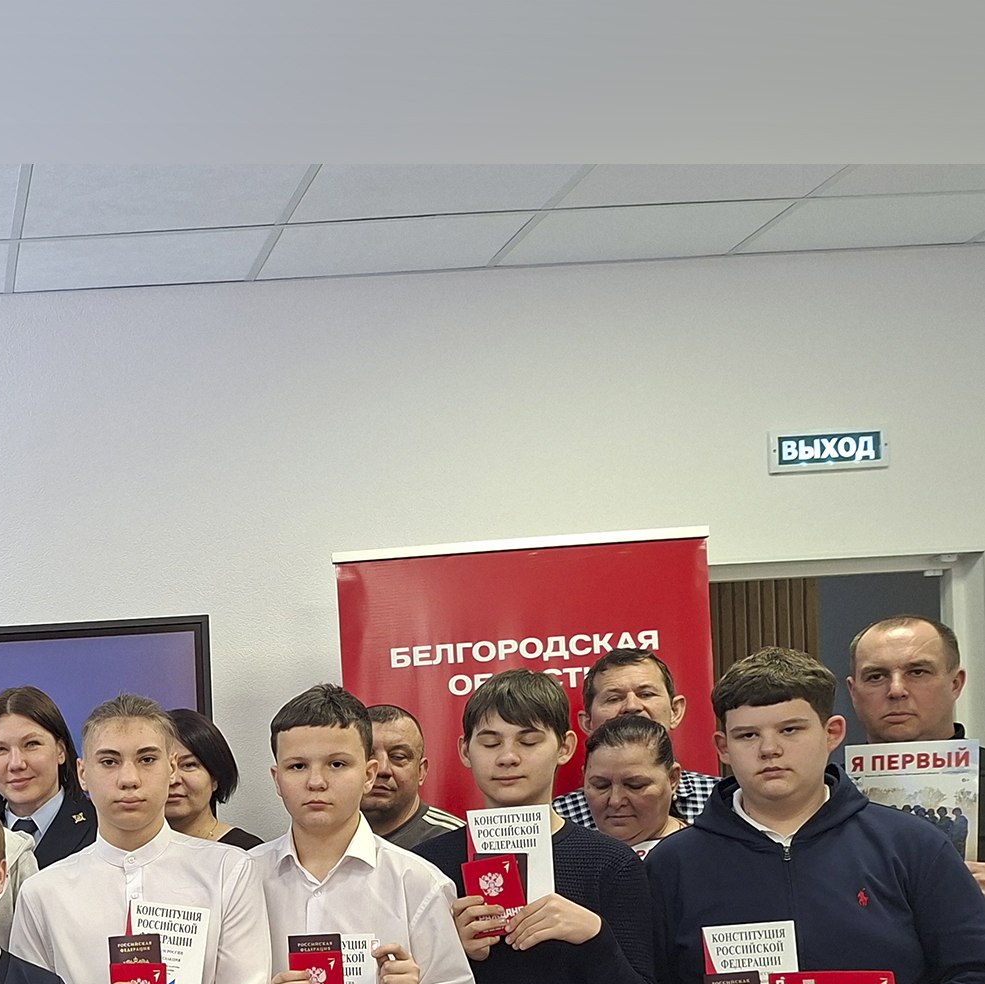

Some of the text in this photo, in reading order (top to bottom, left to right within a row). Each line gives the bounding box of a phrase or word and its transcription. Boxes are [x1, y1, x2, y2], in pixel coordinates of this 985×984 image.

[782, 436, 876, 461] ВЫХОД
[390, 630, 659, 668] БЕЛГОРОДСКАЯ
[851, 747, 970, 772] Я ПЕРВЫЙ
[474, 812, 541, 826] КОНСТИТУЦИЯ
[477, 823, 539, 838] РОССИЙСКОЙ
[481, 838, 536, 850] ФЕДЕРАЦИИ
[136, 905, 202, 922] КОНСТИТУЦИЯ
[137, 918, 197, 934] РОССИЙСКОЙ
[161, 934, 192, 947] РАЦИИ
[712, 929, 785, 943] КОНСТИТУЦИЯ
[716, 940, 784, 956] РОССИЙСКОЙ
[720, 956, 781, 969] ФЕДЕРАЦИИ
